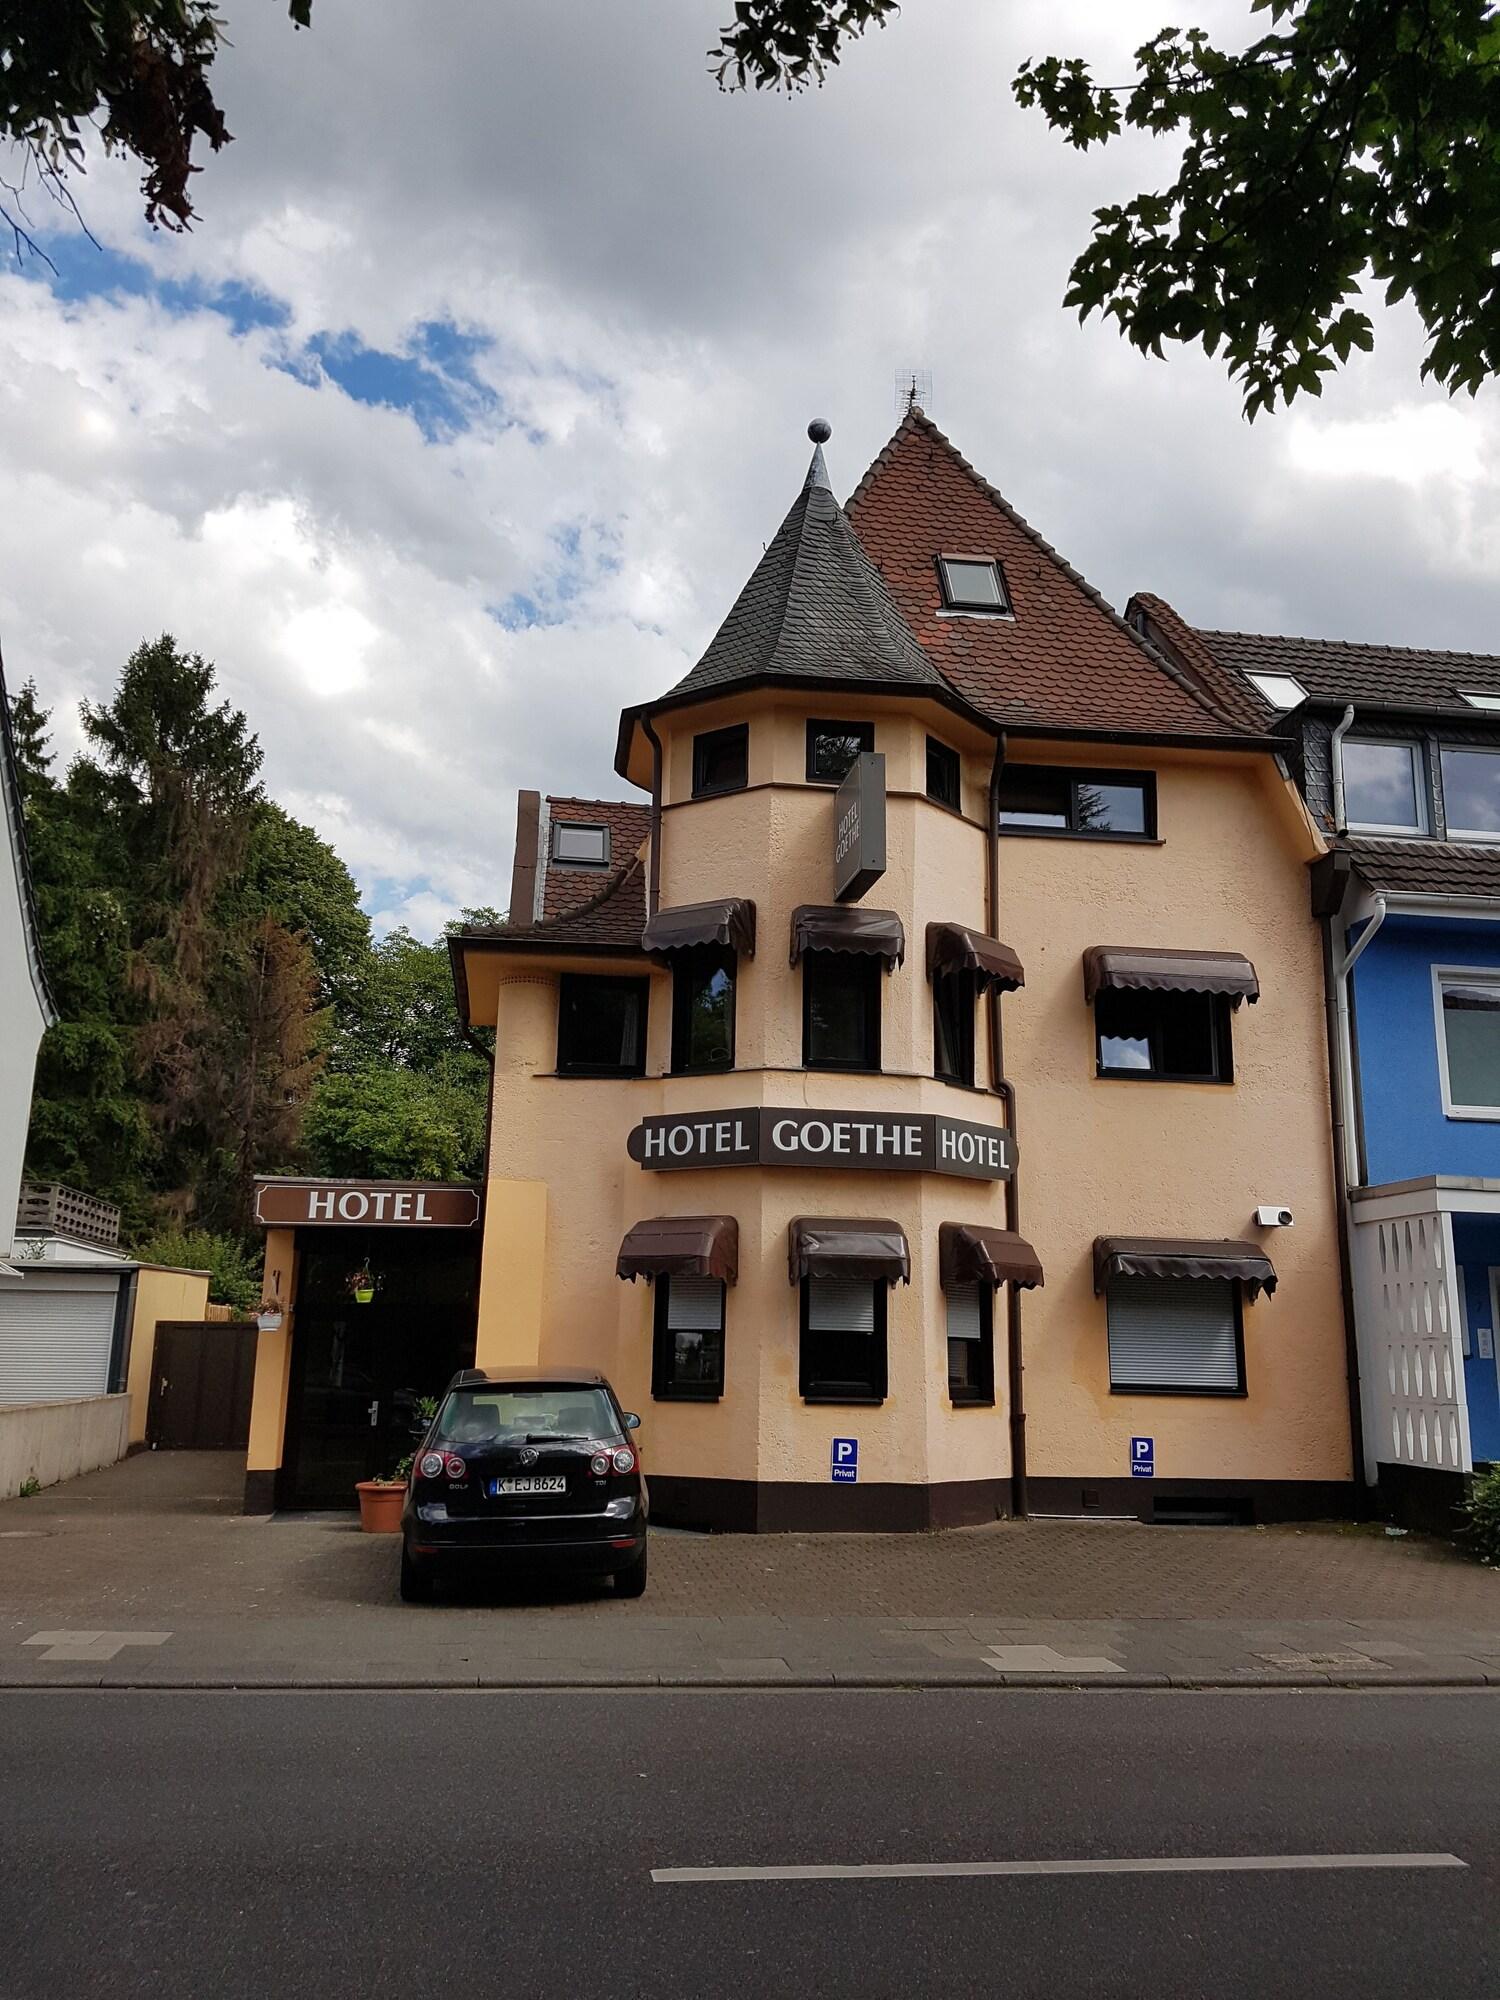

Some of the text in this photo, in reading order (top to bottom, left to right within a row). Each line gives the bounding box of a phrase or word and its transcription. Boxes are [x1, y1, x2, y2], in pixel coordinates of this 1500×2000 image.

[839, 802, 858, 840] HOTEL
[836, 820, 859, 863] GOETHE
[645, 1119, 1010, 1169] HOTEL GOETHE HOTEL
[308, 1191, 432, 1221] HOTEL
[838, 1442, 852, 1461] P
[1136, 1441, 1149, 1458] P
[834, 1469, 854, 1477] Privat
[1133, 1465, 1152, 1473] Privat
[497, 1477, 564, 1492] K EJ 8624
